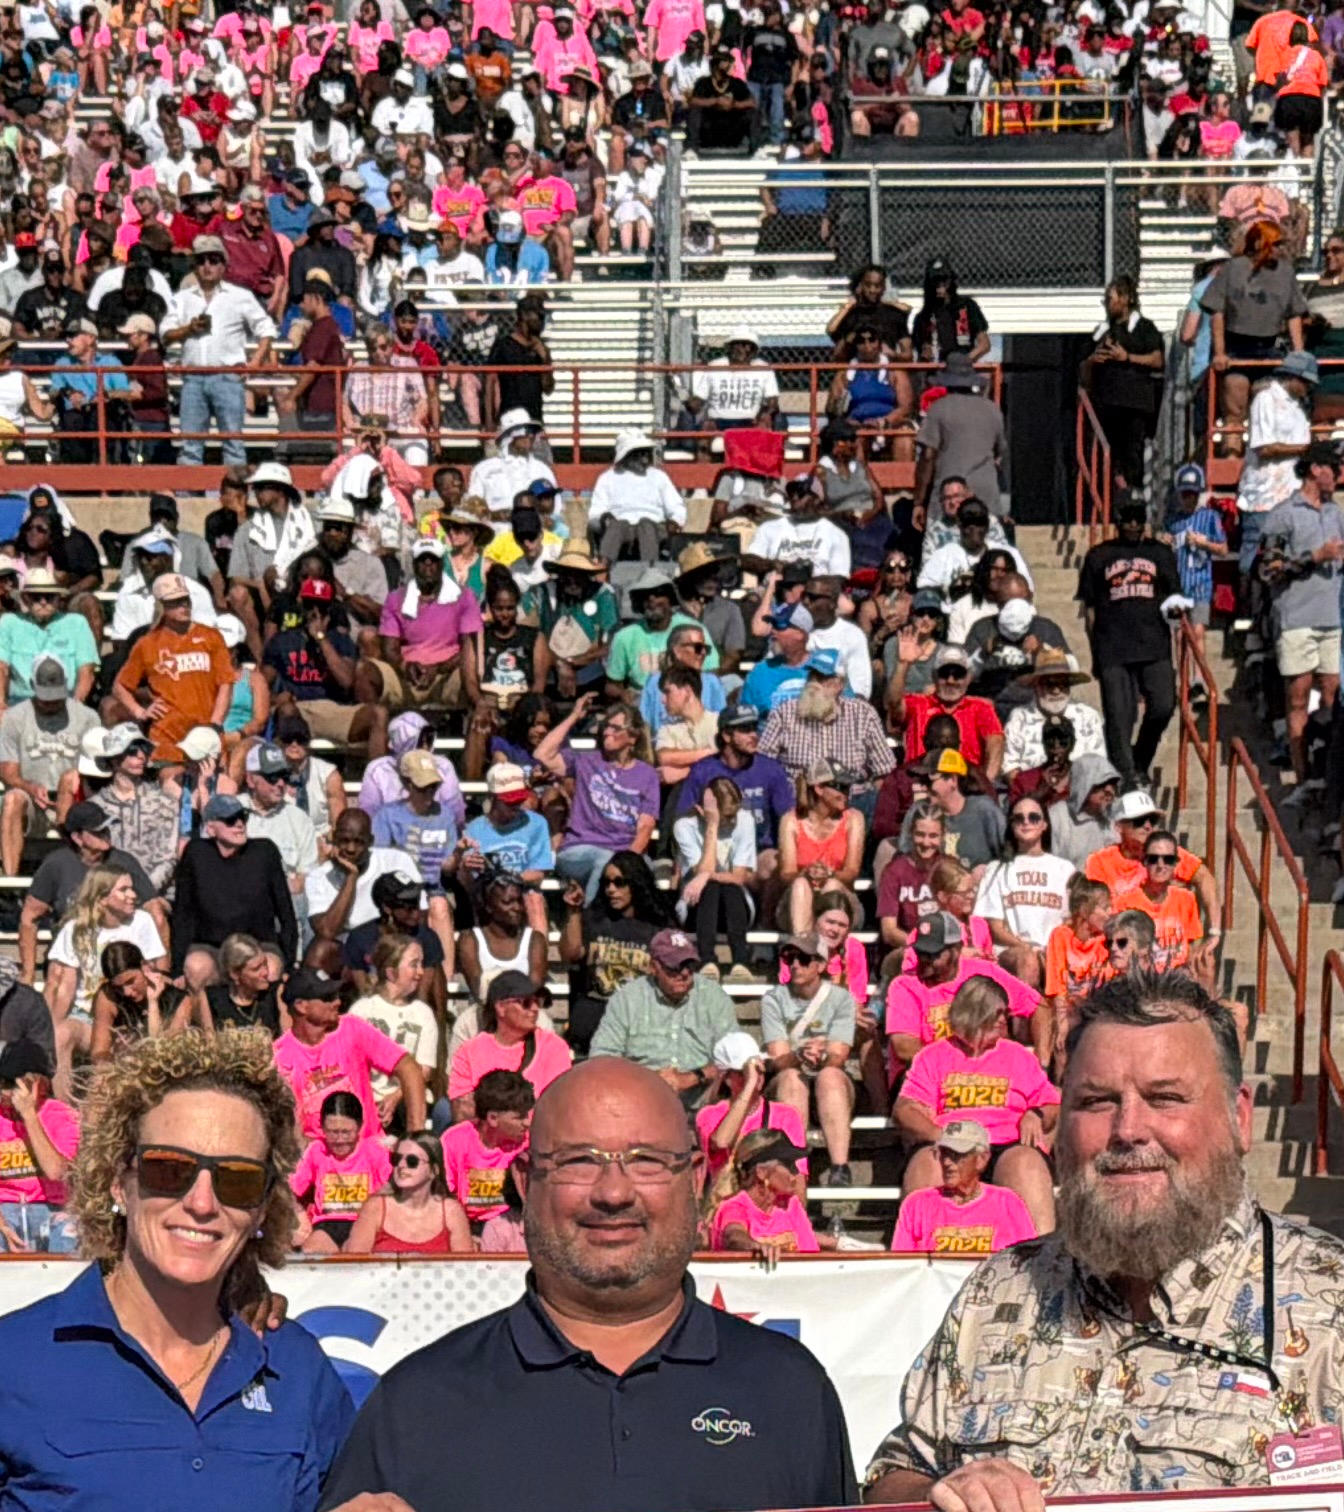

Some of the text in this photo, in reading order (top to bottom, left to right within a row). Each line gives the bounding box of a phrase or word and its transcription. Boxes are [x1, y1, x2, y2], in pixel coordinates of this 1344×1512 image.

[1016, 870, 1048, 887] TEXAS
[945, 1085, 1008, 1108] 2026
[323, 1185, 368, 1204] 2026
[691, 1415, 753, 1437] ONCOR
